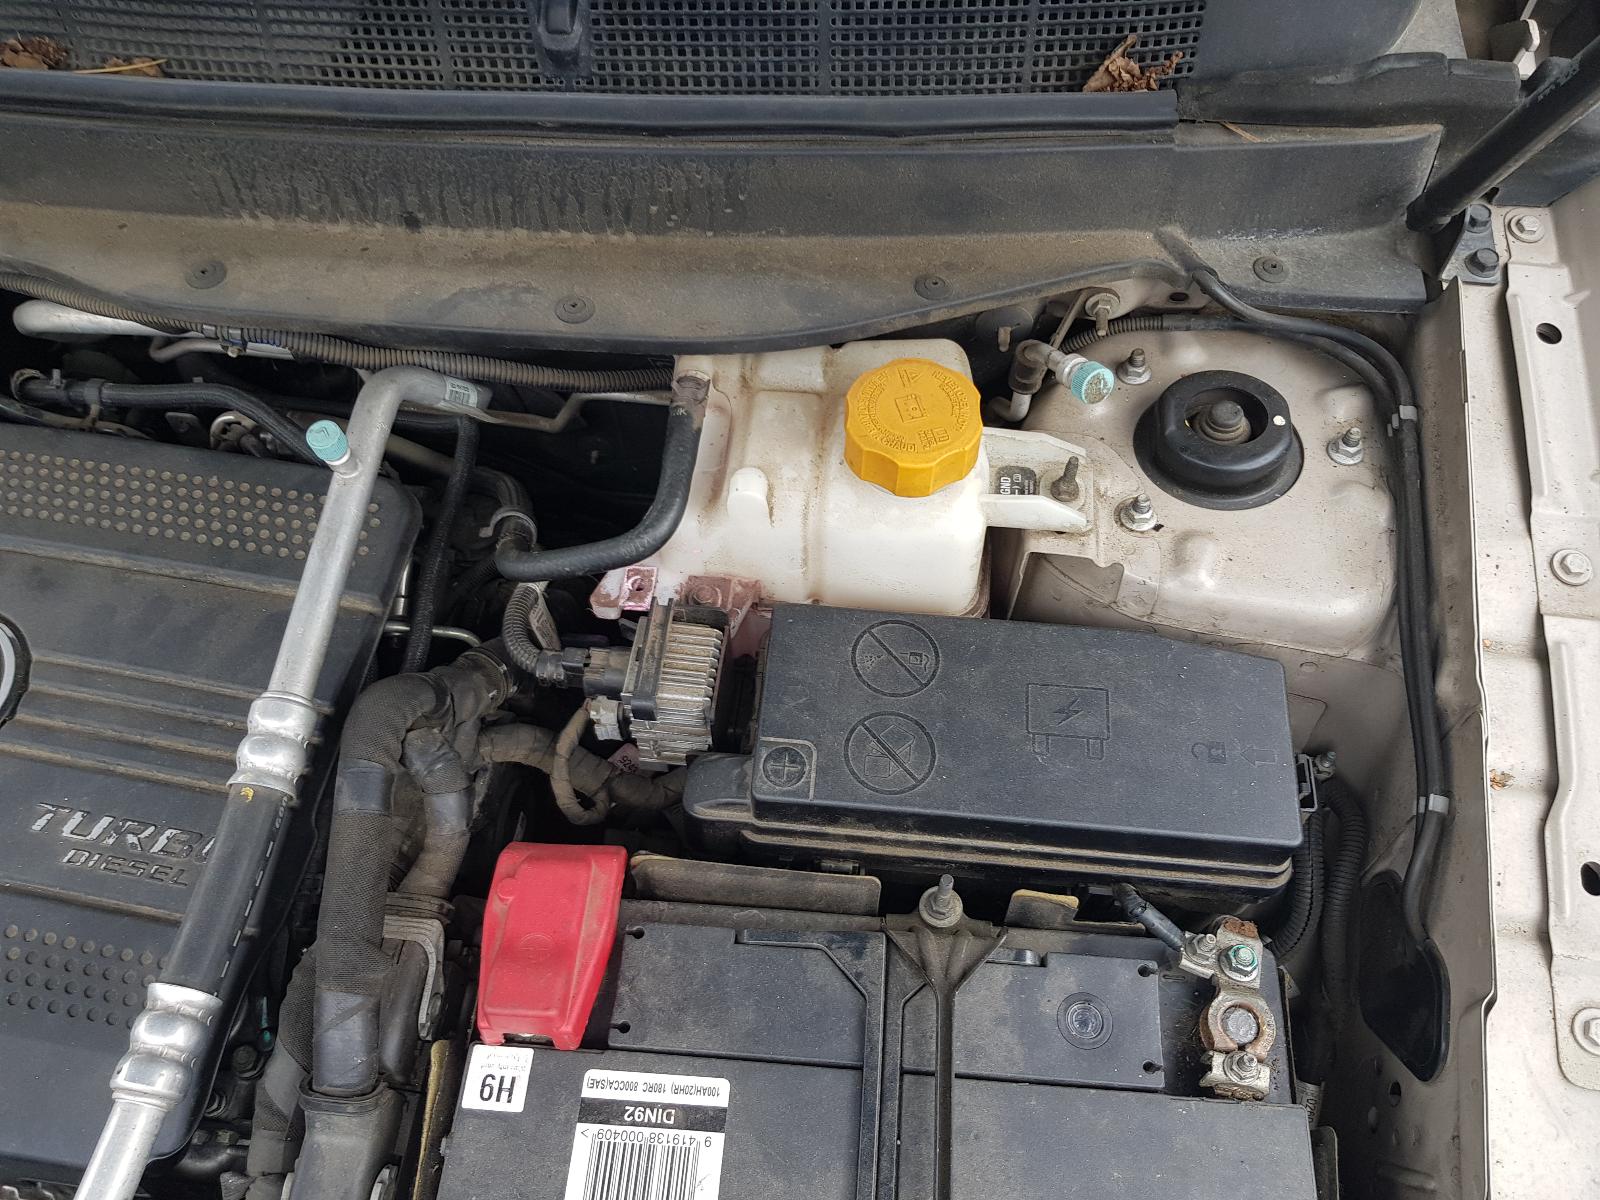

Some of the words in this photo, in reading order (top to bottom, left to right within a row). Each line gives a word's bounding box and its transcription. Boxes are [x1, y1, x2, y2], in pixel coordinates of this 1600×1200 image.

[1000, 476, 1011, 495] GND
[62, 848, 188, 887] DIESEL
[480, 1073, 516, 1104] H9
[587, 1076, 639, 1092] 800CCA(SAE)
[642, 1081, 666, 1094] 180RC
[671, 1083, 720, 1098] 100AH(20HR)
[624, 1105, 676, 1125] DIN92
[597, 1128, 644, 1142] 000409
[649, 1131, 696, 1146] 419138
[704, 1135, 712, 1148] 9
